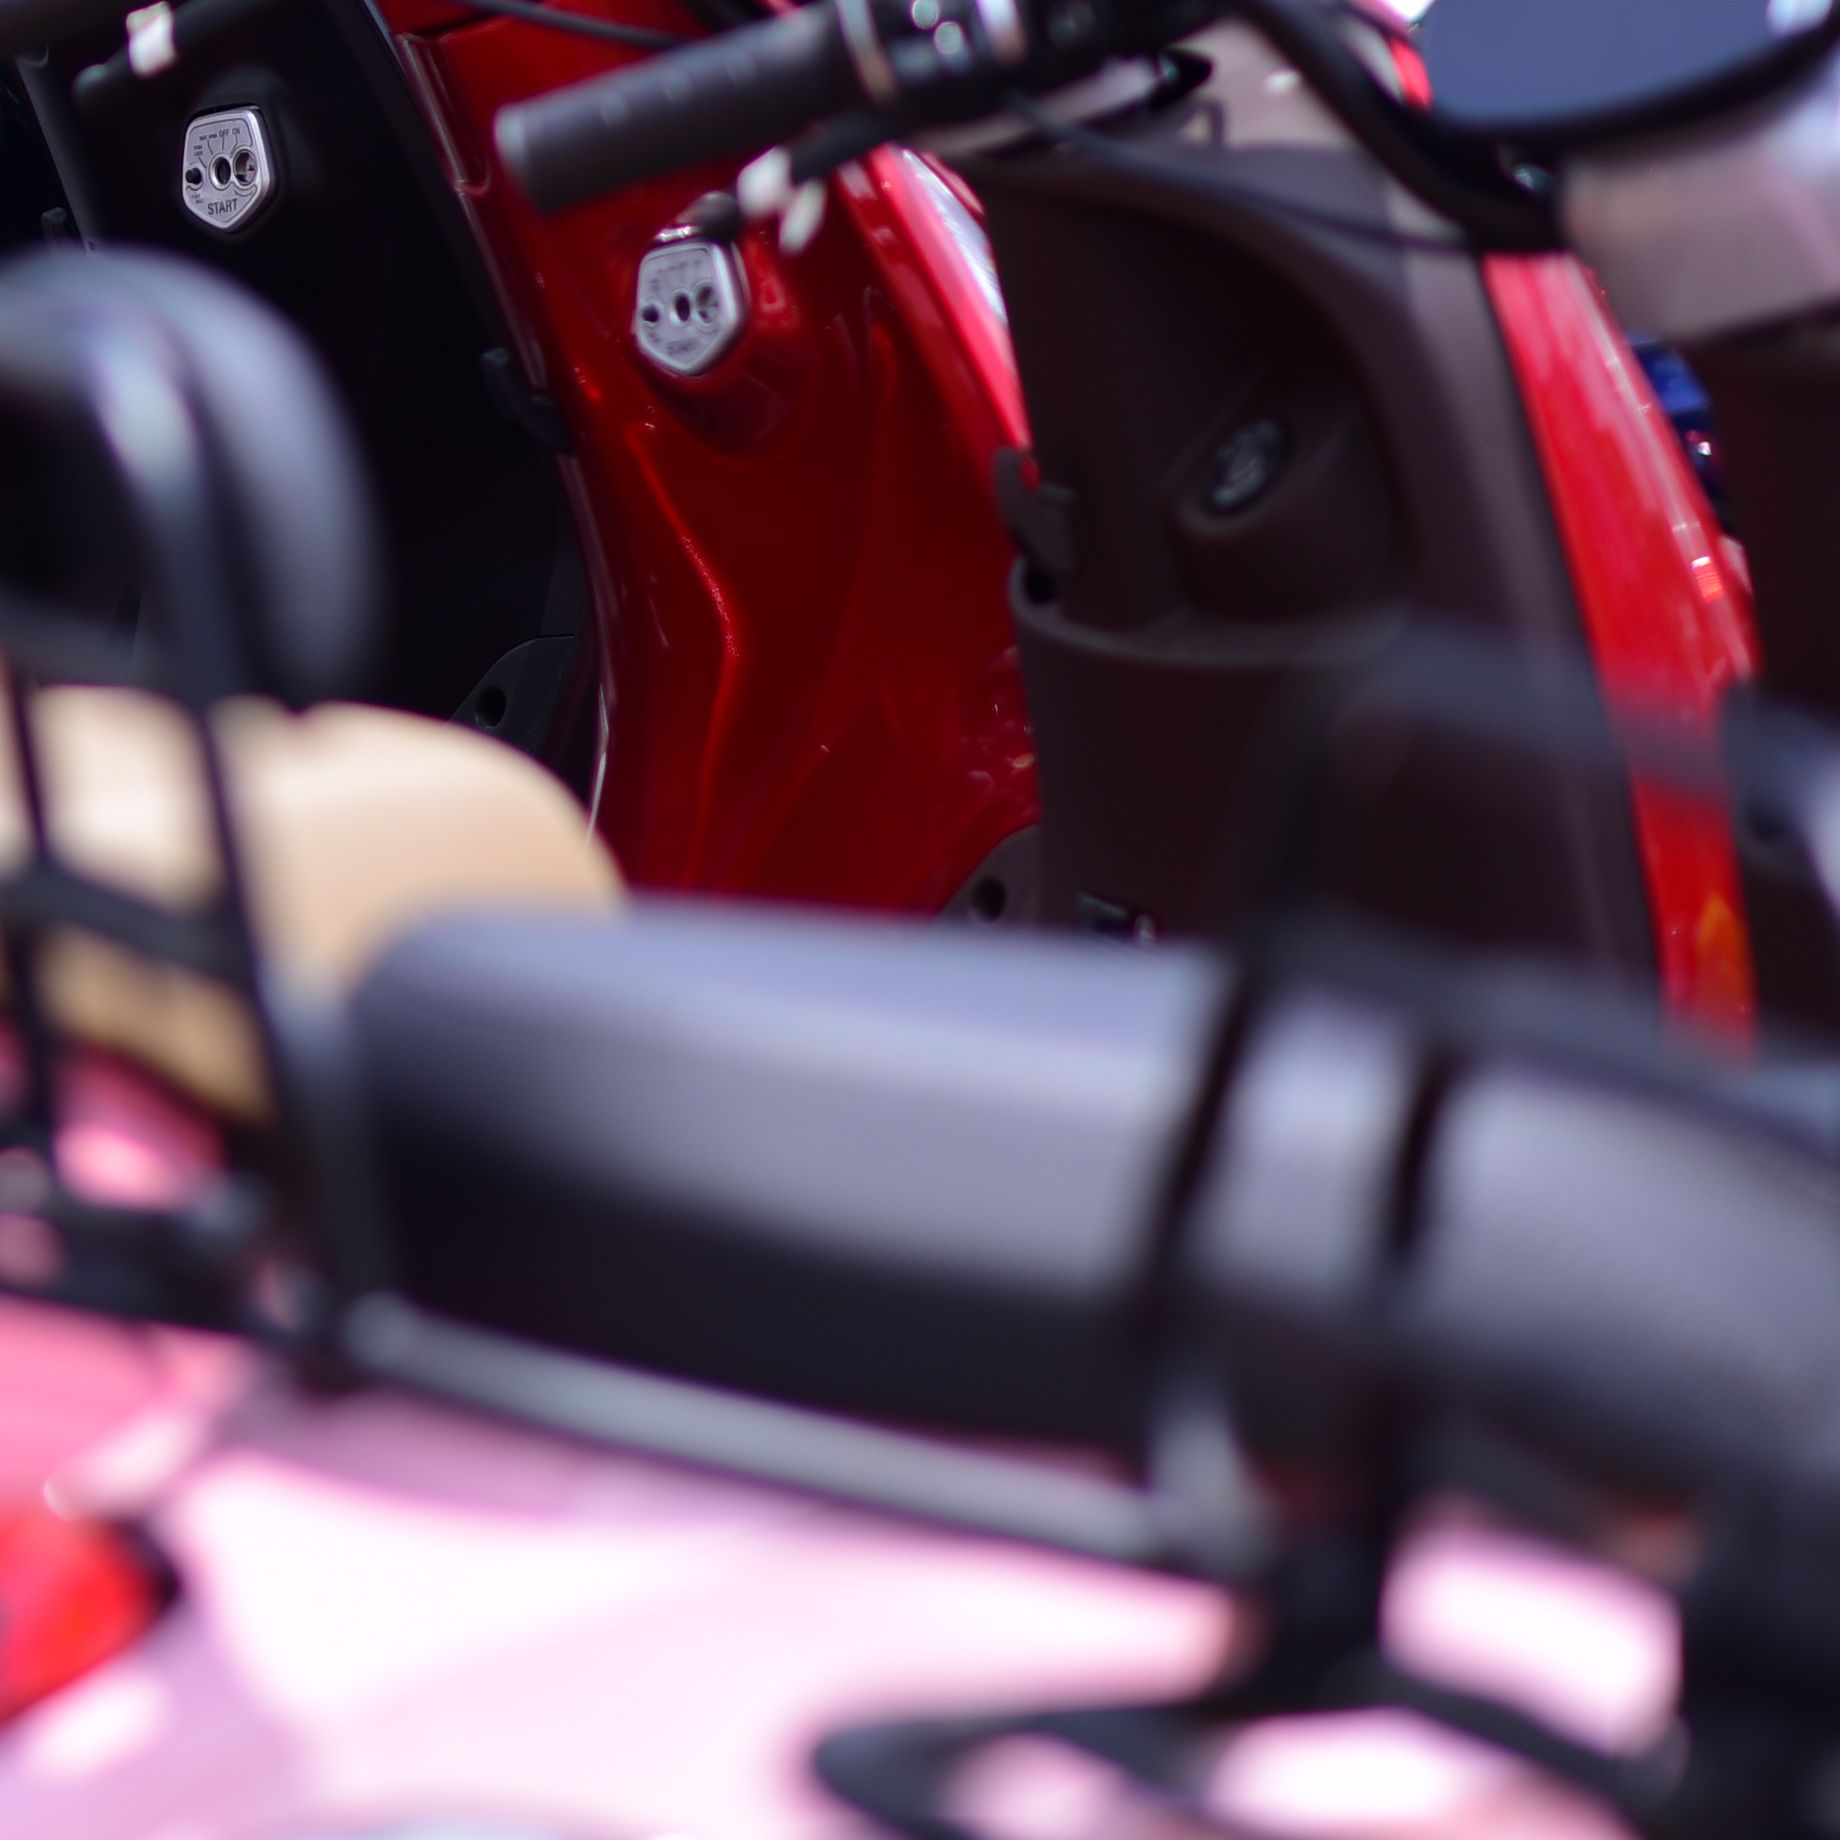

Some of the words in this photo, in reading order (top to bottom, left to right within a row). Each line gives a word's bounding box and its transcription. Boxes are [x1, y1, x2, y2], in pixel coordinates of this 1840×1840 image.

[218, 129, 230, 138] OFF
[232, 127, 241, 136] ON
[207, 198, 238, 216] START
